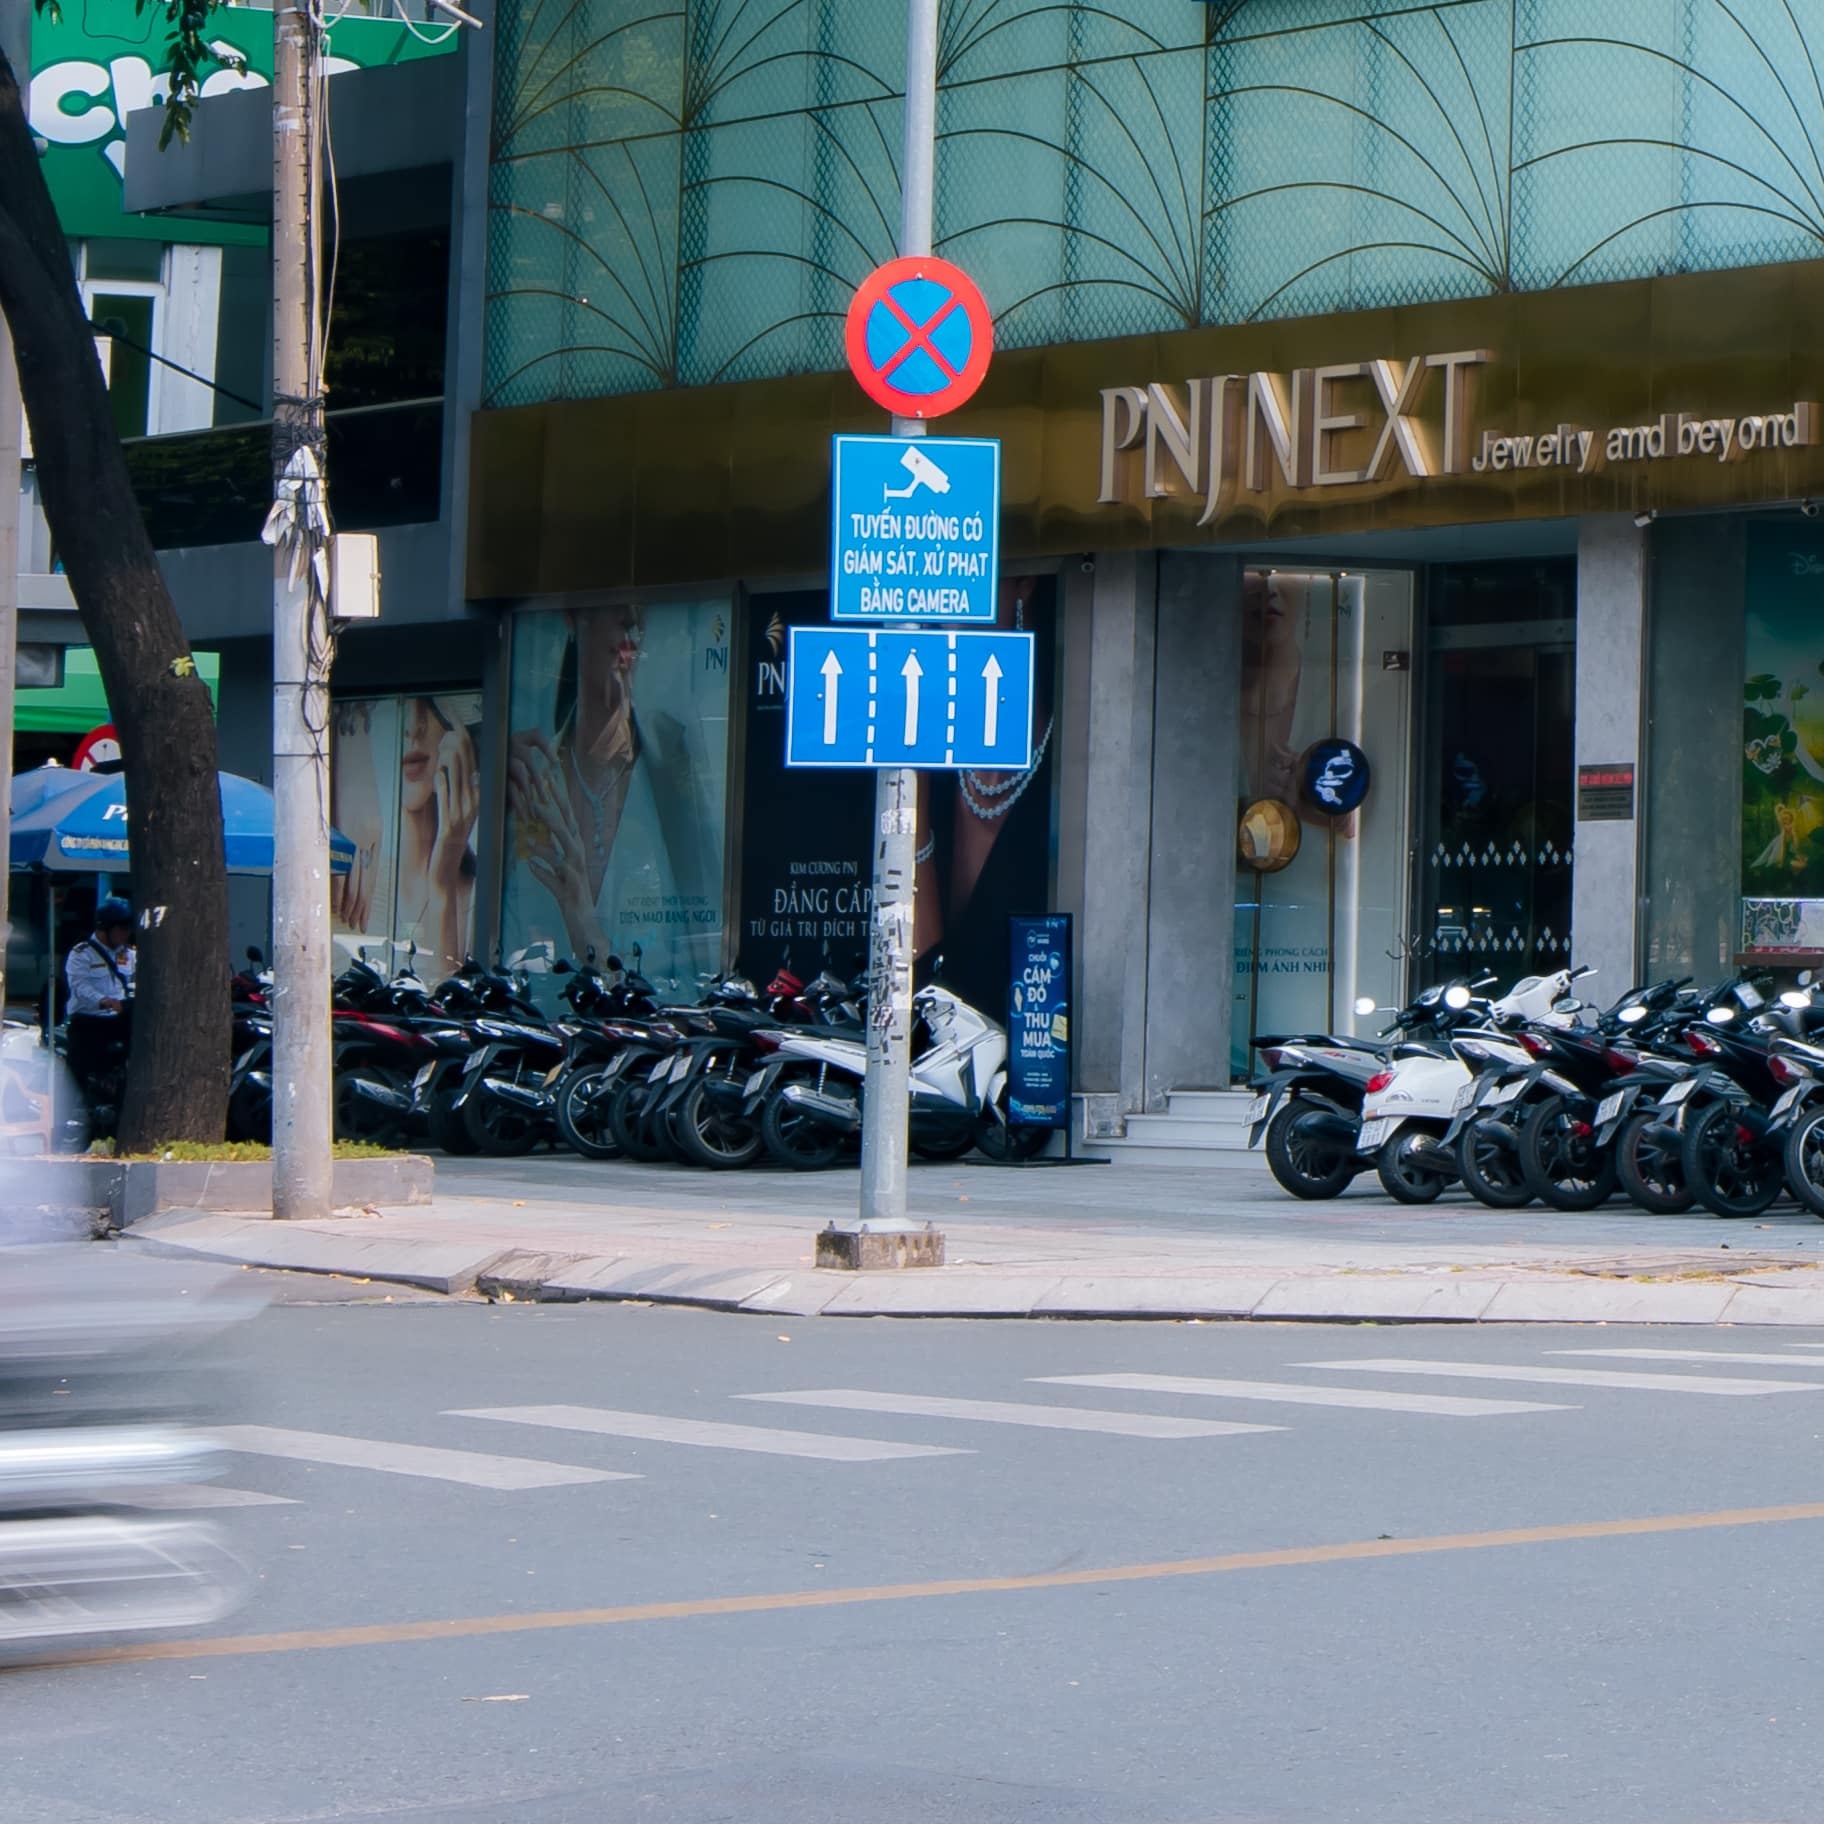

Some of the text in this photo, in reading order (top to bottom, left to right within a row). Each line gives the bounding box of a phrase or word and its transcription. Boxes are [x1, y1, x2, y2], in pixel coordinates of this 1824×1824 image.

[1471, 401, 1821, 475] Jewelry and beyond
[851, 506, 983, 542] TUYẾN ĐƯỜNG CÓ
[844, 543, 883, 574] GIÁM
[923, 543, 945, 576] XỬ
[948, 552, 988, 582] PHẠT
[860, 576, 969, 614] BẰNG CAMERA
[705, 647, 728, 673] PNJ
[790, 862, 807, 875] KIM
[774, 881, 828, 914] ĐẲNG
[1236, 960, 1268, 974] ĐIM
[1303, 959, 1331, 973] NHÌ
[1023, 1012, 1050, 1028] THU
[1023, 1031, 1051, 1047] MUA
